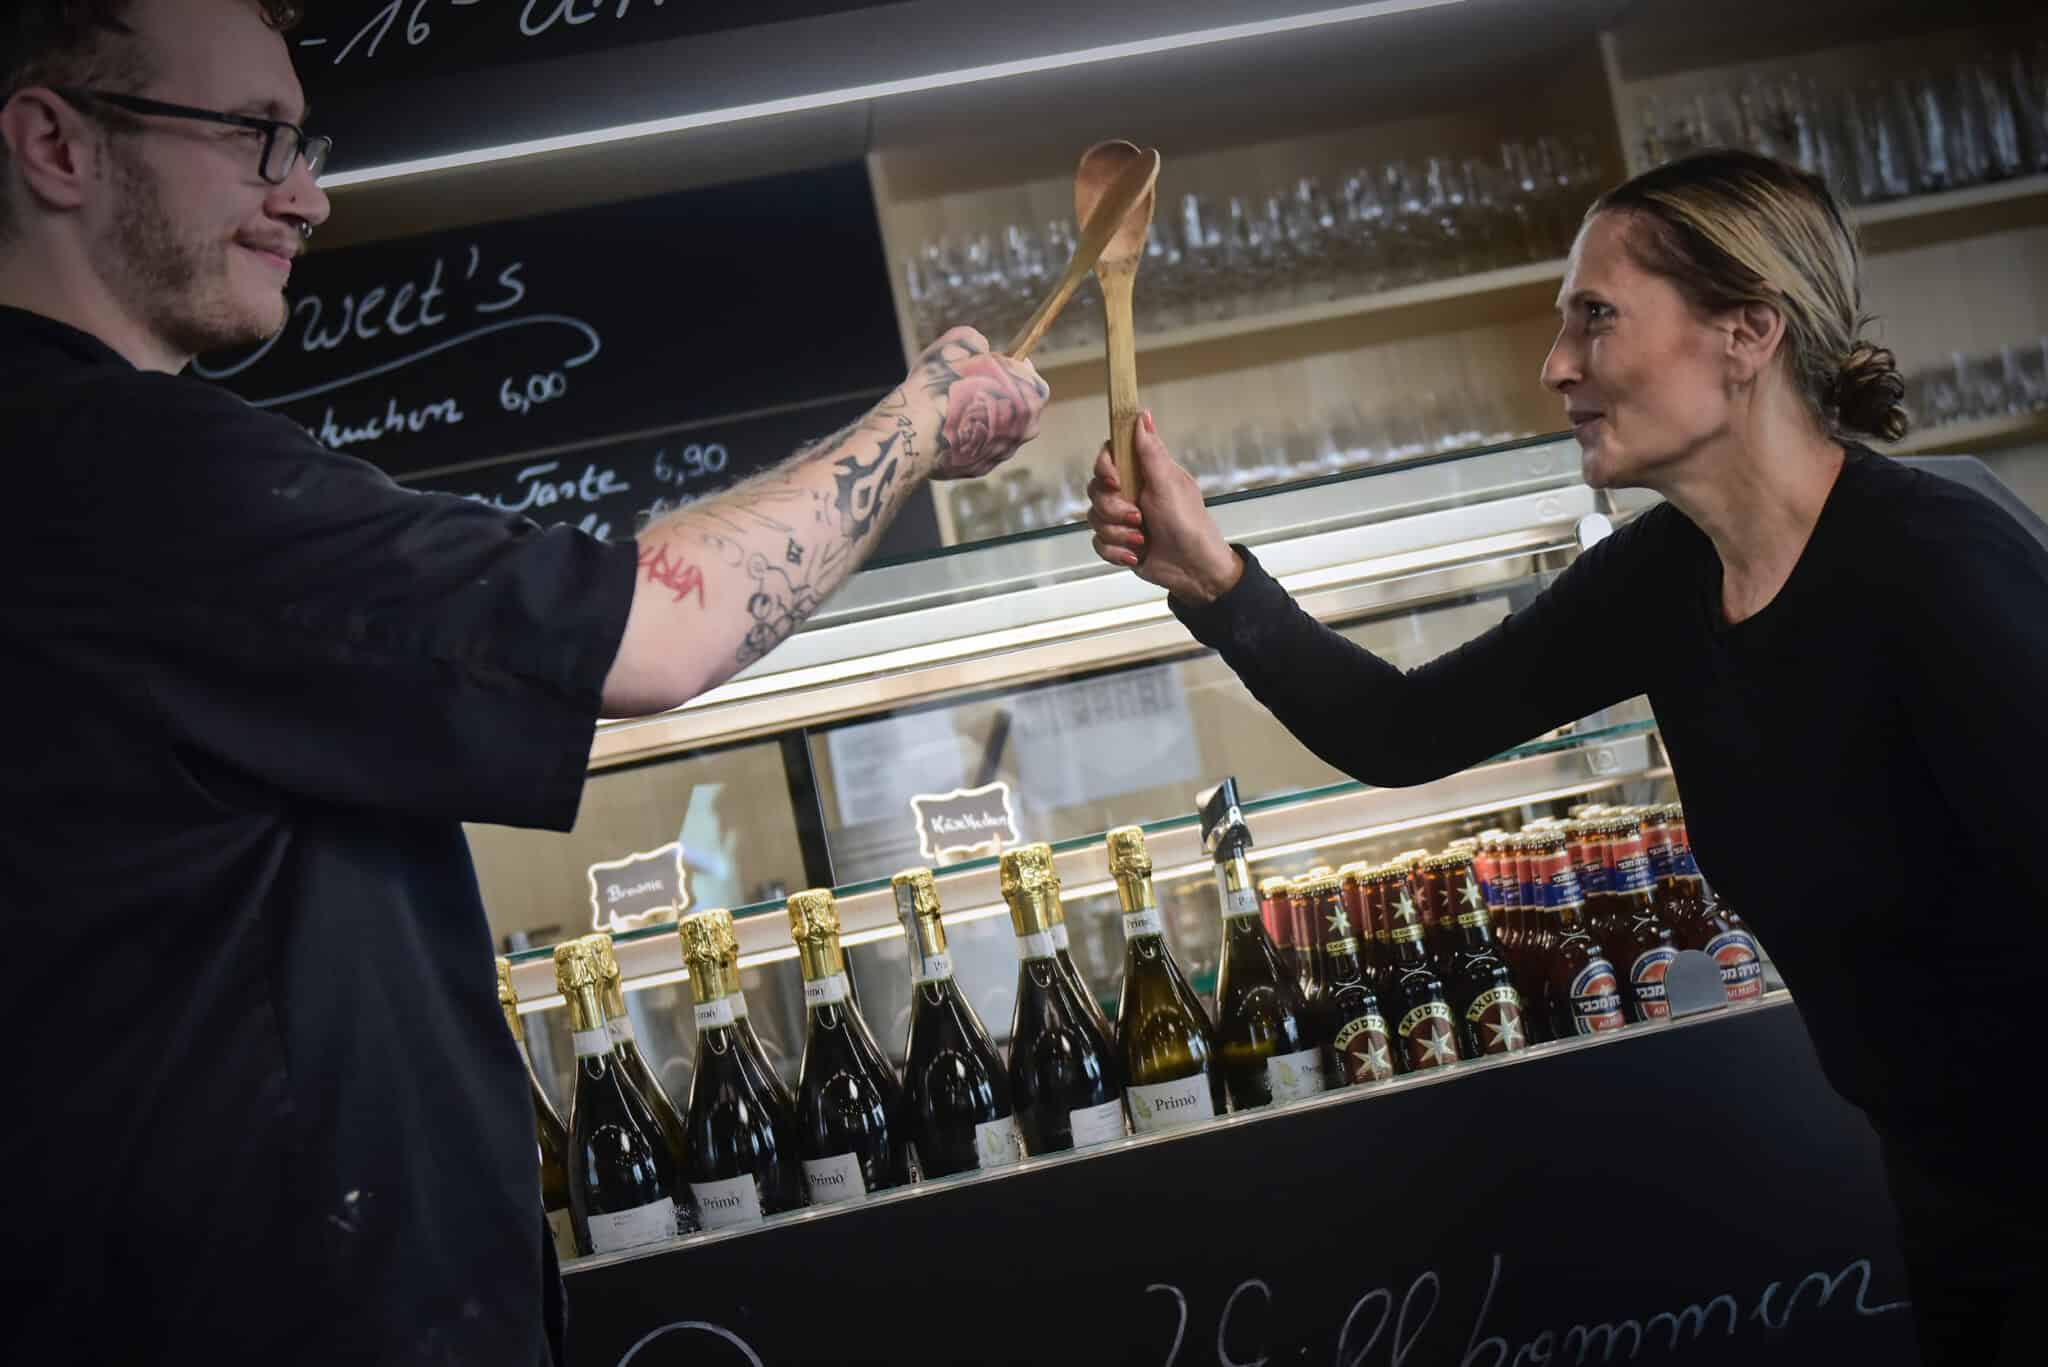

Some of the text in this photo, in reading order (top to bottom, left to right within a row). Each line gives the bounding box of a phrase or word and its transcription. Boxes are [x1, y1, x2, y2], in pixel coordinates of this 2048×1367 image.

[309, 371, 567, 447] kuchen 6,00
[654, 443, 728, 486] 6,90
